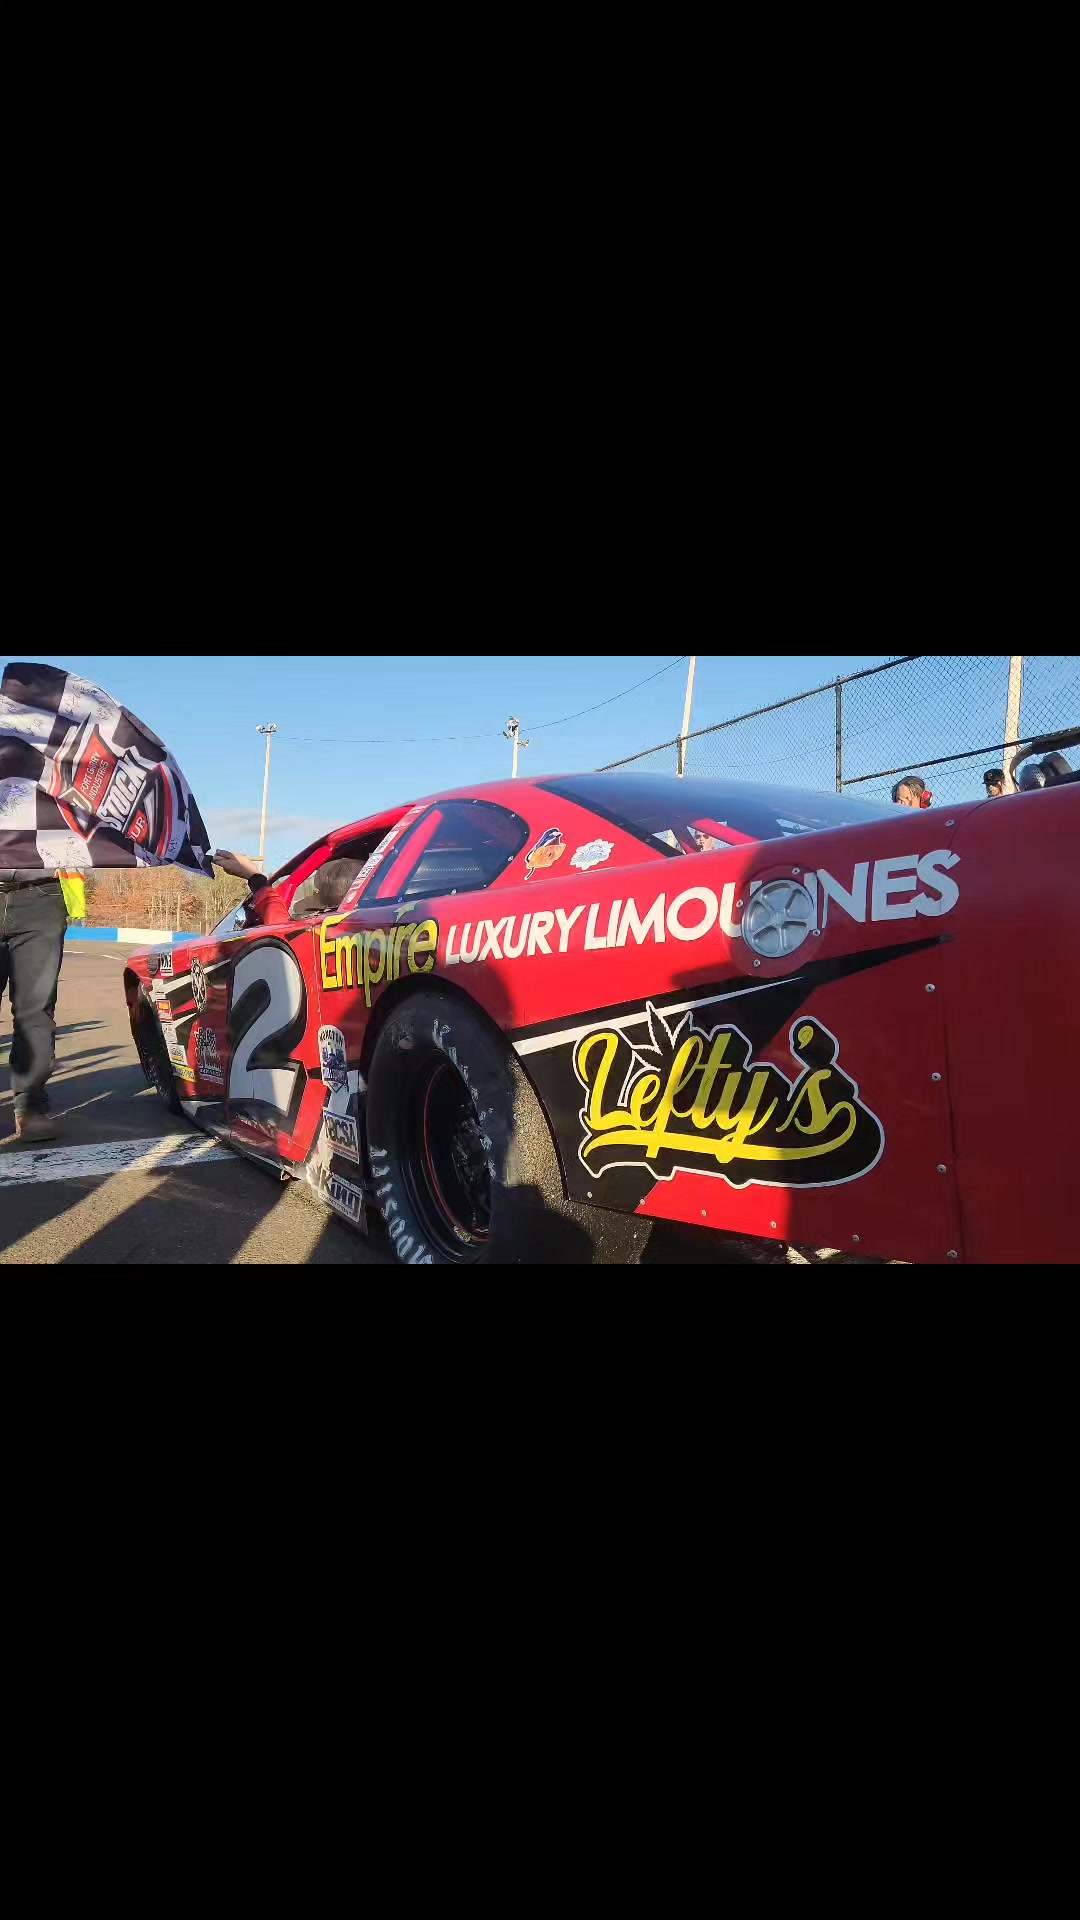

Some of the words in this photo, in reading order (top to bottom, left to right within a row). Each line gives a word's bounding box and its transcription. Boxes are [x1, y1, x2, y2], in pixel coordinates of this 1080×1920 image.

[99, 754, 147, 831] STOCK
[320, 903, 438, 1008] Empire
[445, 905, 588, 965] LUXURY
[584, 849, 961, 952] LIMOUINES
[228, 944, 303, 1118] 2
[577, 1025, 857, 1164] Lefty's
